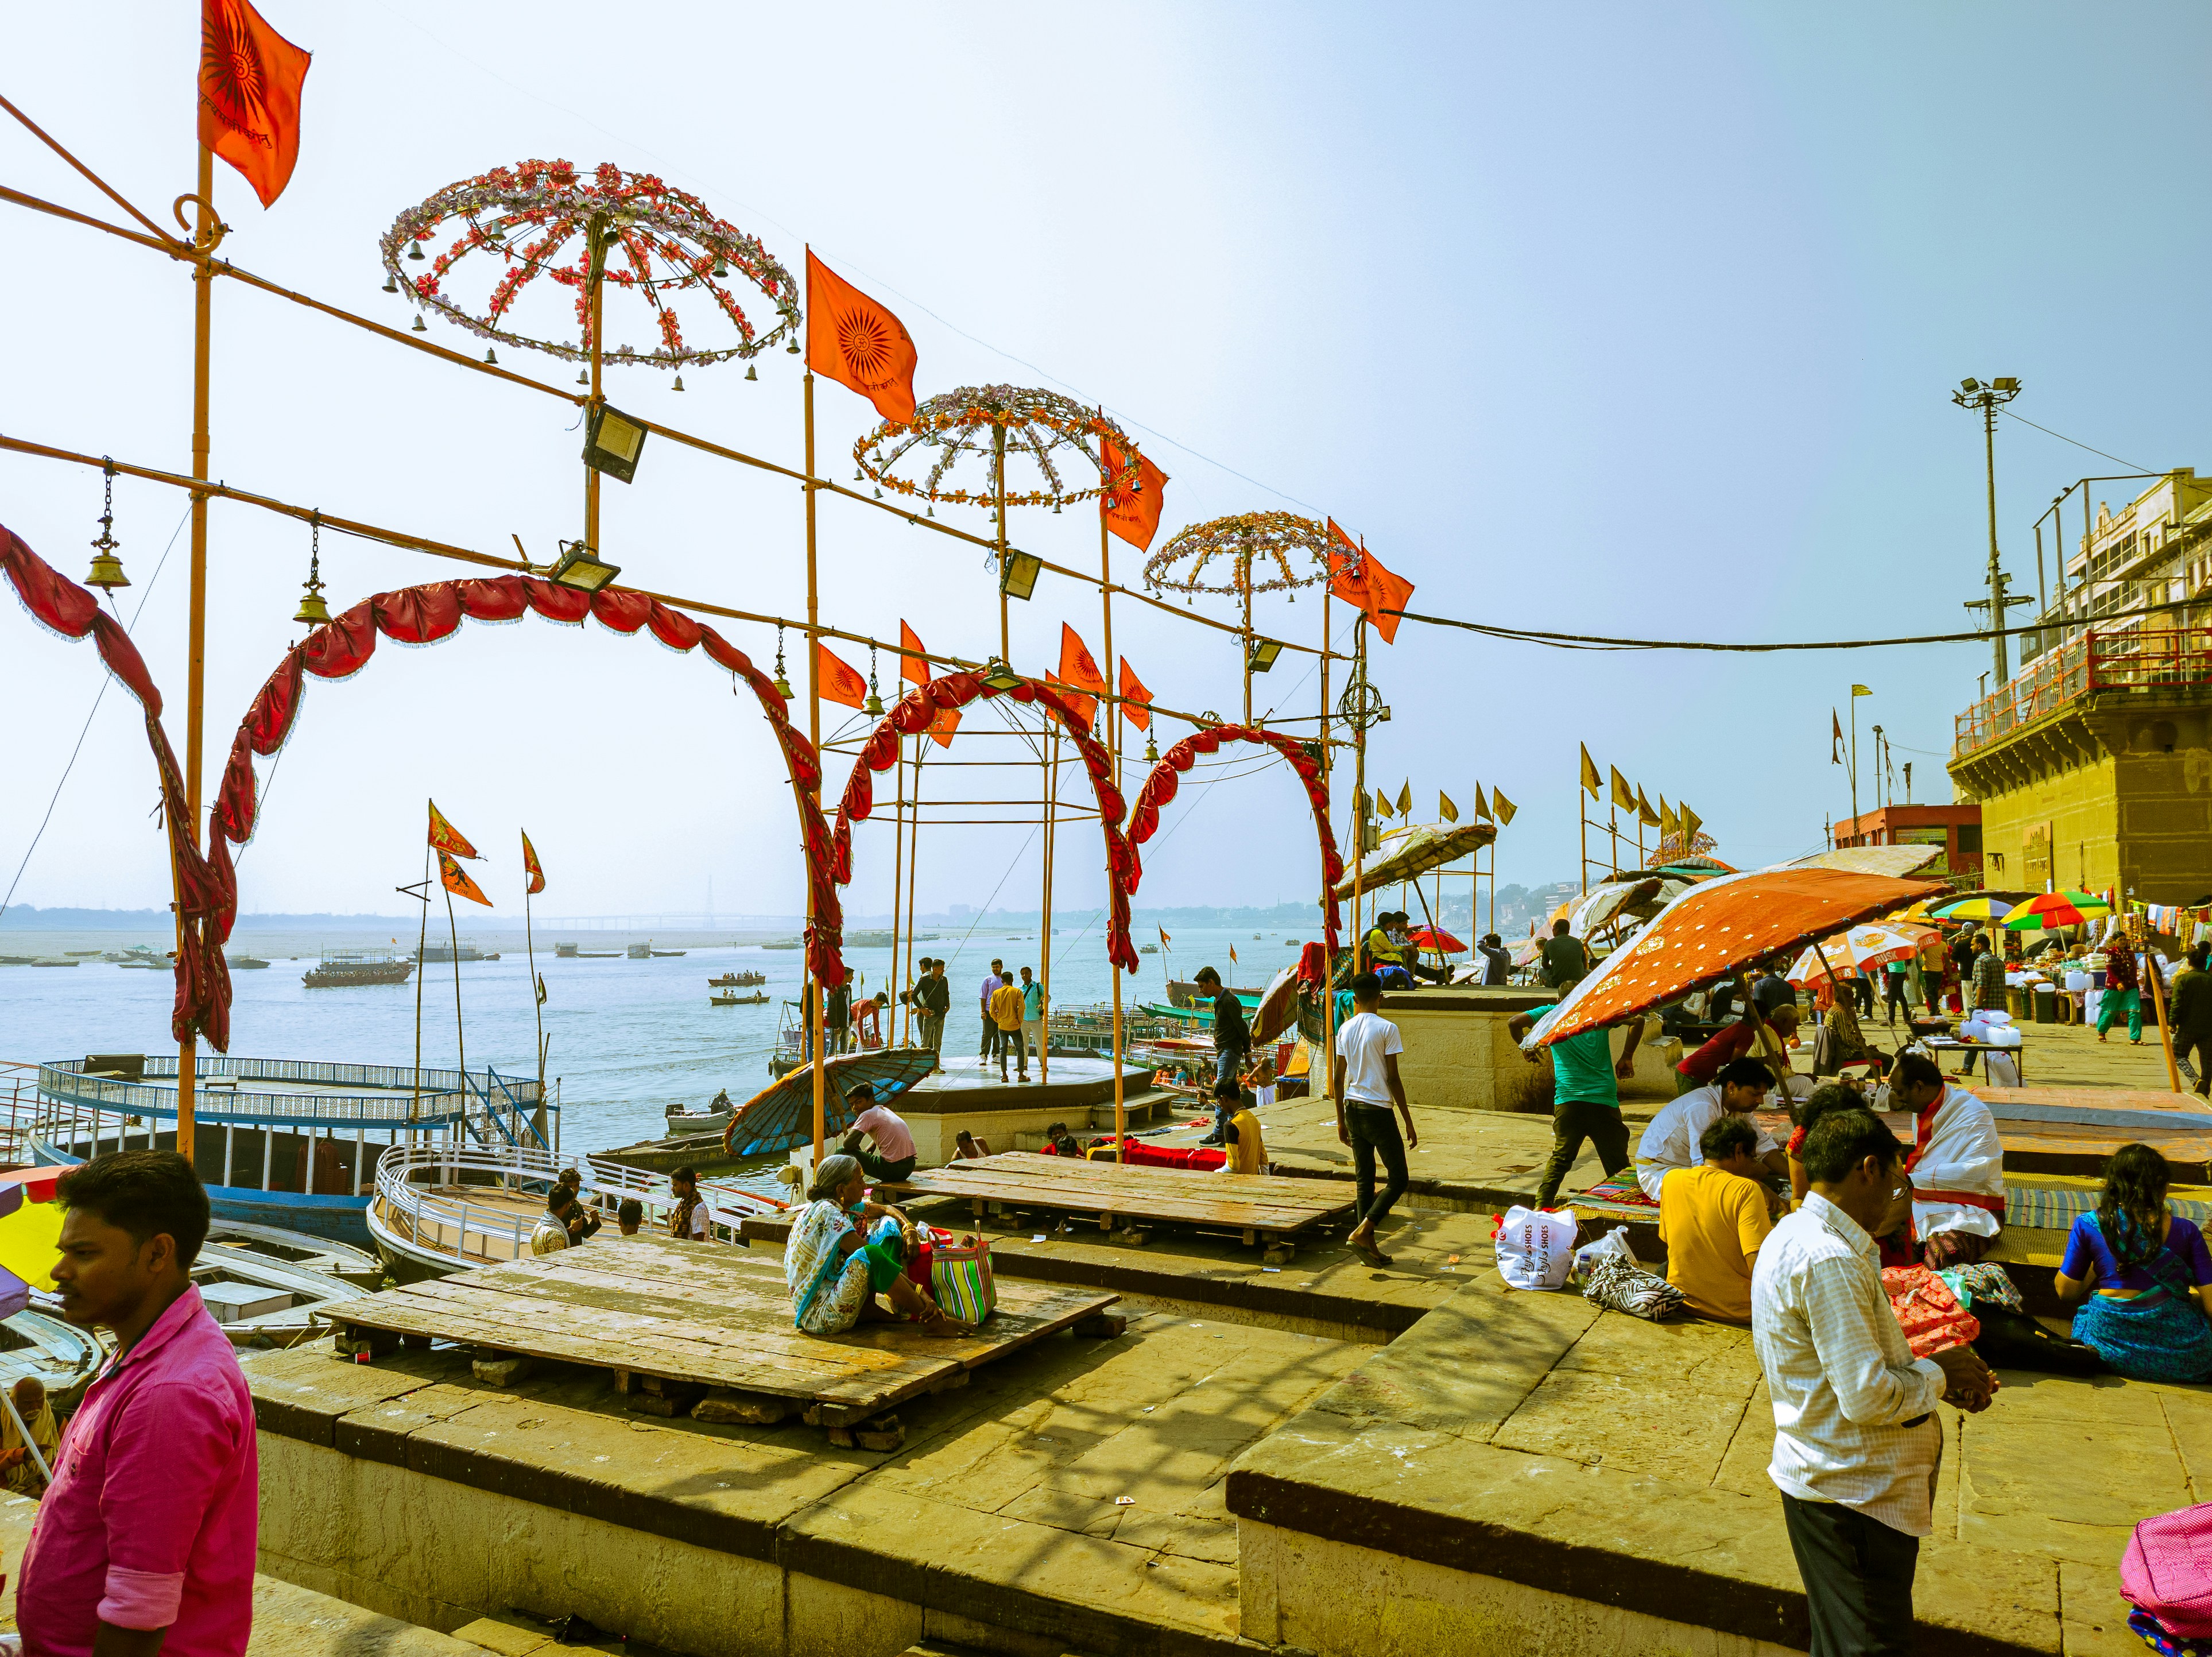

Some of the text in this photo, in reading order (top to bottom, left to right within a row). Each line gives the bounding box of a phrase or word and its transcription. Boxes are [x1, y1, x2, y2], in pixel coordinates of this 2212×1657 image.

[458, 888, 468, 896] राम
[1874, 951, 1898, 965] RUSK
[1520, 1250, 1535, 1283] Style
[1536, 1251, 1551, 1286] Style
